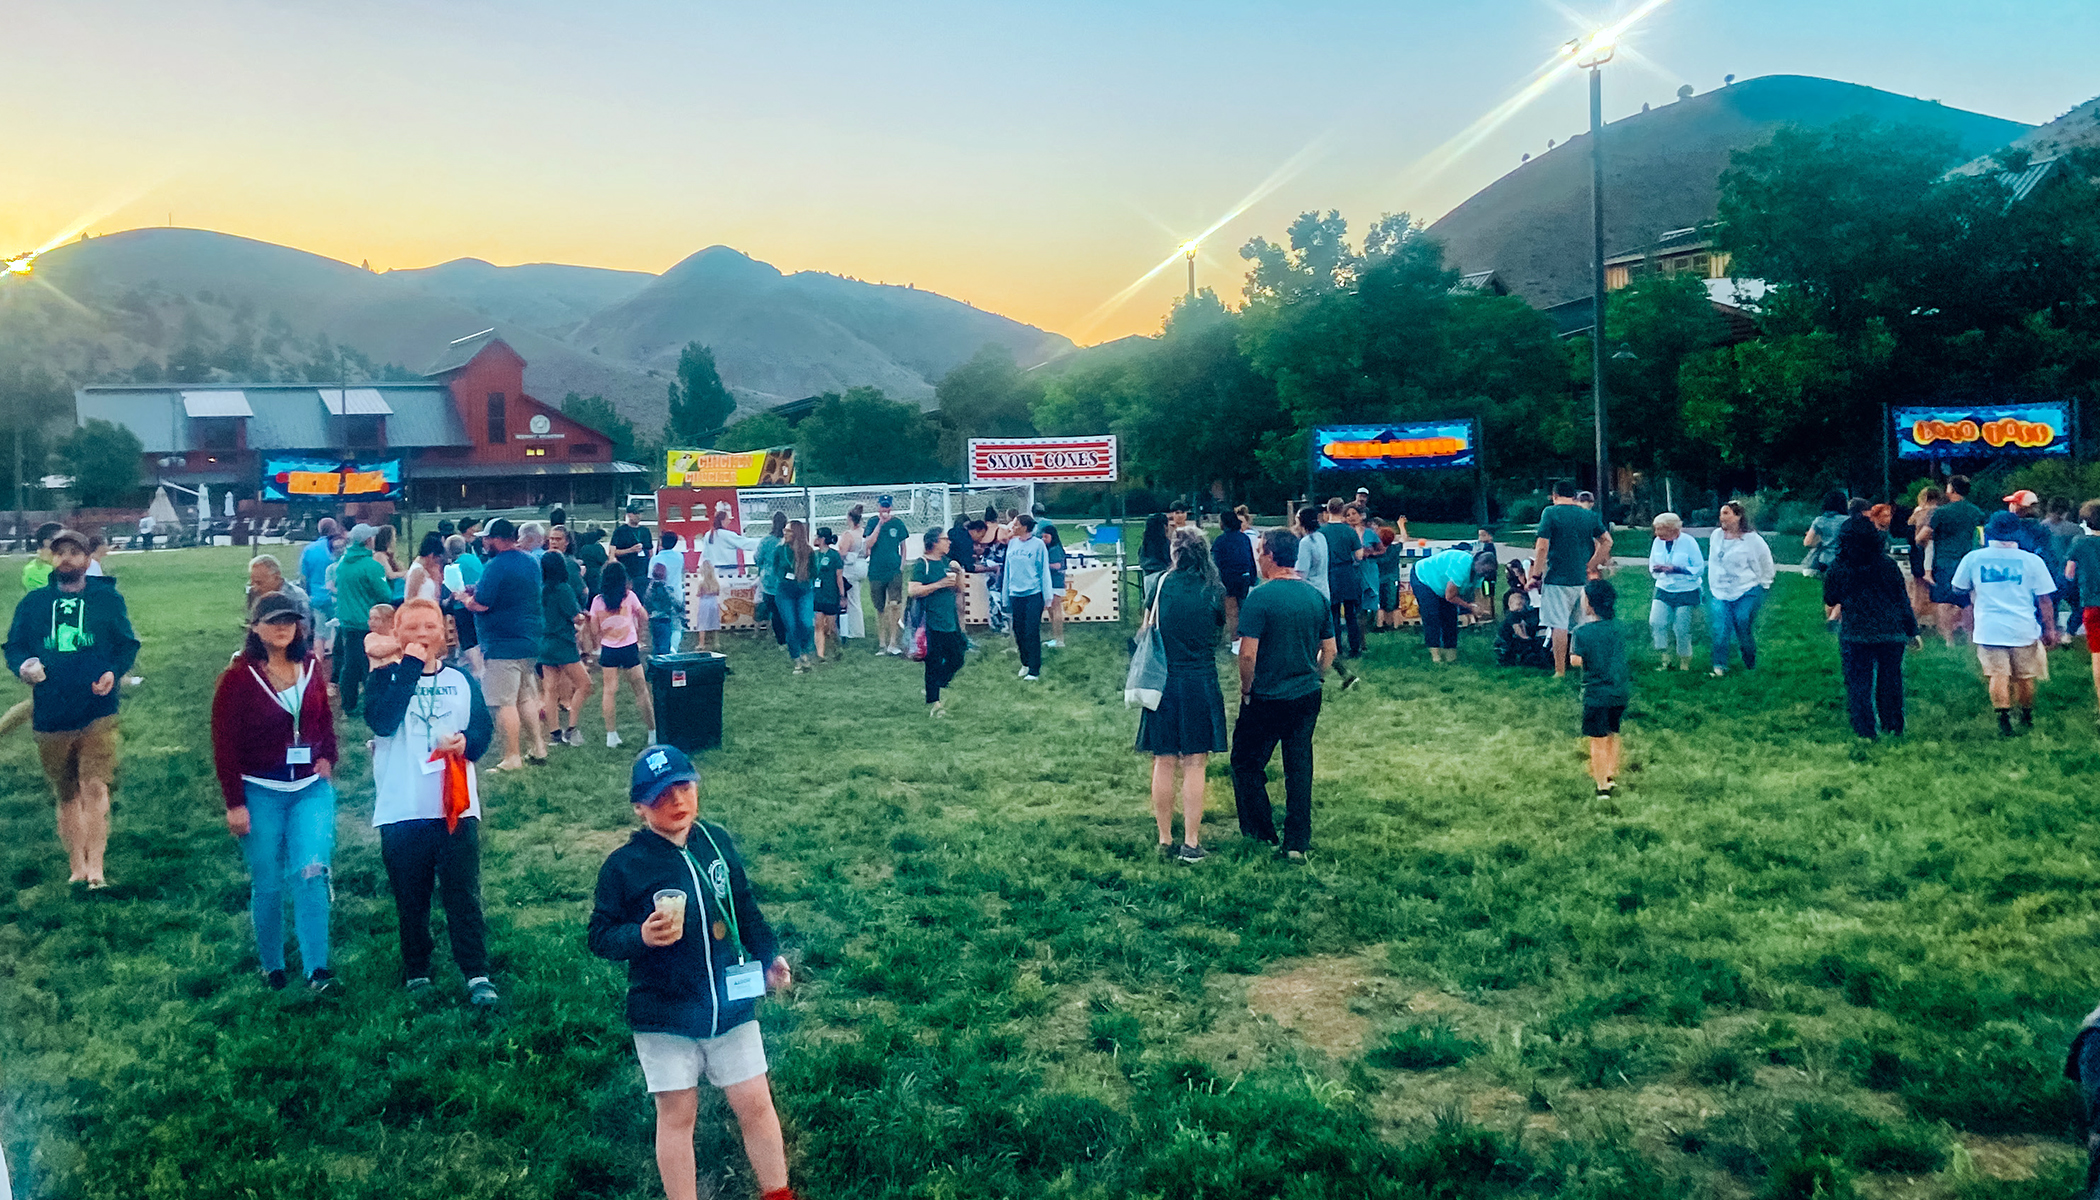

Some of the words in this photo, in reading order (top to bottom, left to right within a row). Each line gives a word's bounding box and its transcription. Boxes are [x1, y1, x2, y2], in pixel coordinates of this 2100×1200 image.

[1988, 422, 2046, 443] TOSS
[697, 455, 754, 468] CHICKEN
[988, 453, 1035, 469] SNOW
[1043, 451, 1099, 468] CONES
